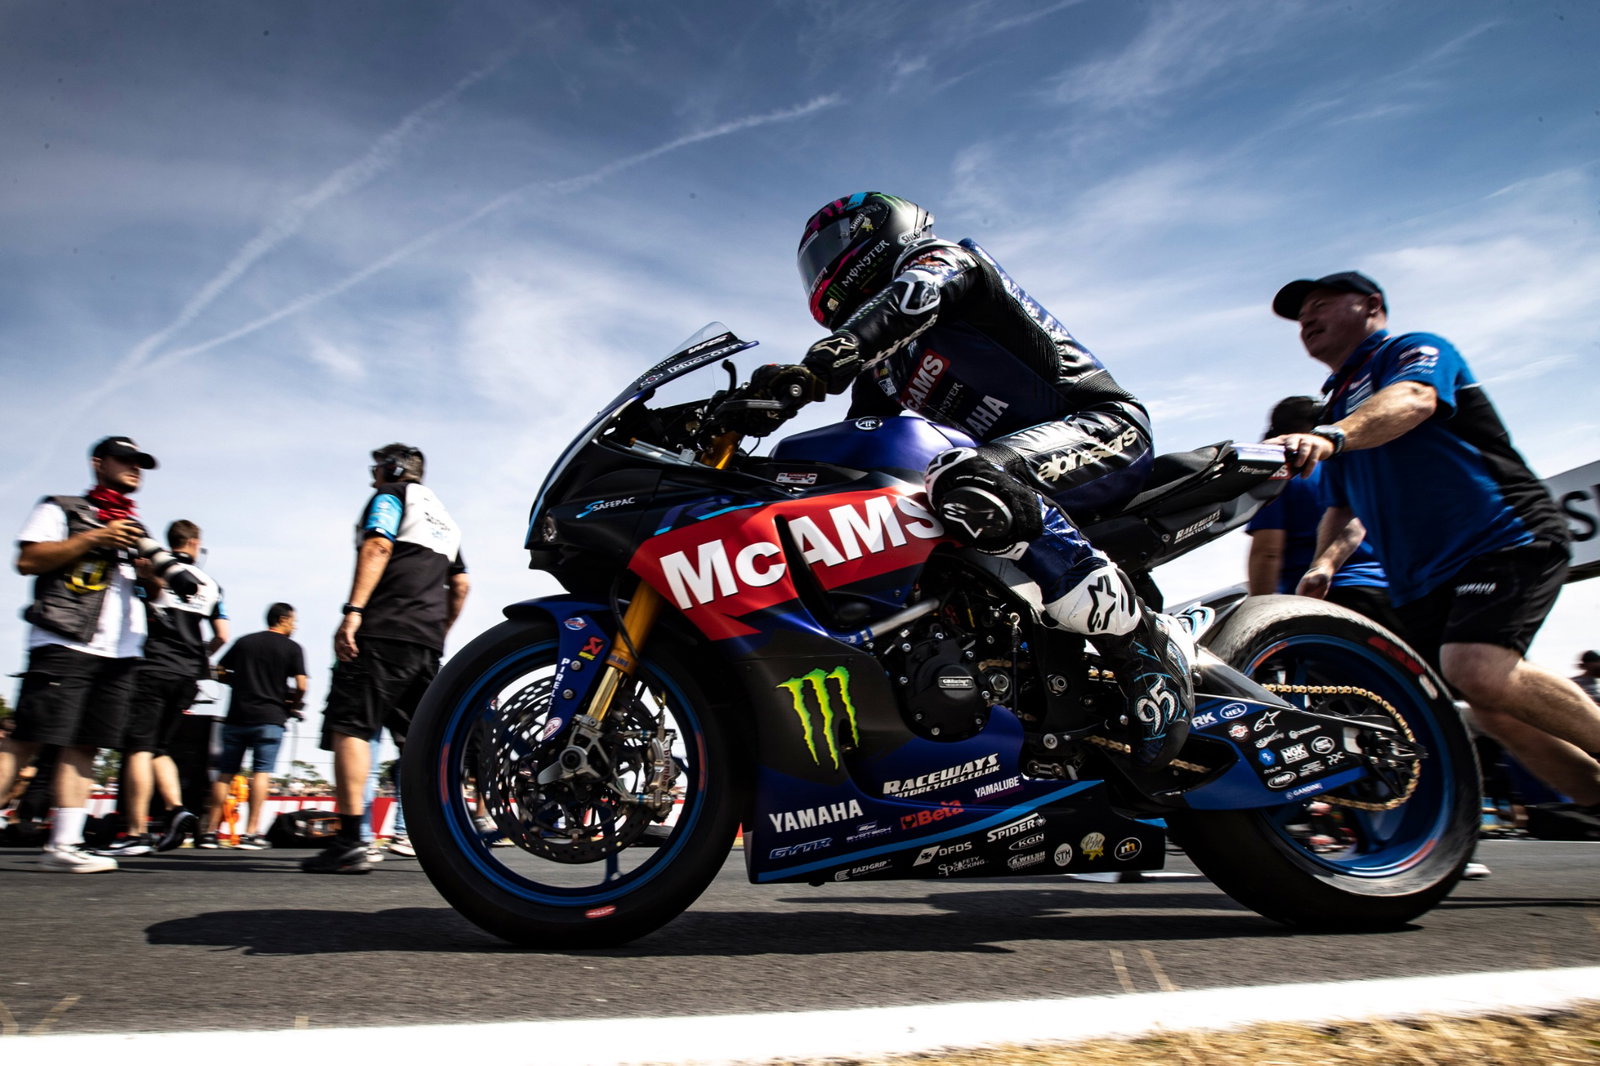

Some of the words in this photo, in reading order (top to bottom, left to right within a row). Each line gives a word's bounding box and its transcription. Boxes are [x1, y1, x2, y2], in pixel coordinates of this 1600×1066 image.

[965, 395, 1009, 437] AHA
[1037, 426, 1137, 482] alpinestars
[585, 497, 636, 513] SAFEPAC
[1562, 485, 1600, 542] S
[659, 496, 945, 610] McAMS
[547, 657, 571, 713] PIRELLI
[1136, 677, 1176, 734] 95
[1224, 706, 1244, 717] HEL
[1191, 711, 1217, 727] RK
[1281, 743, 1308, 761] NGK
[882, 752, 999, 795] RACEWAYS
[974, 775, 1021, 798] YAMALUBE
[768, 798, 864, 833] YAMAHA
[917, 800, 965, 823] Beta
[986, 815, 1038, 843] SPIDER
[1018, 833, 1045, 848] KGN
[939, 841, 973, 857] DFDS
[1055, 851, 1071, 862] STM
